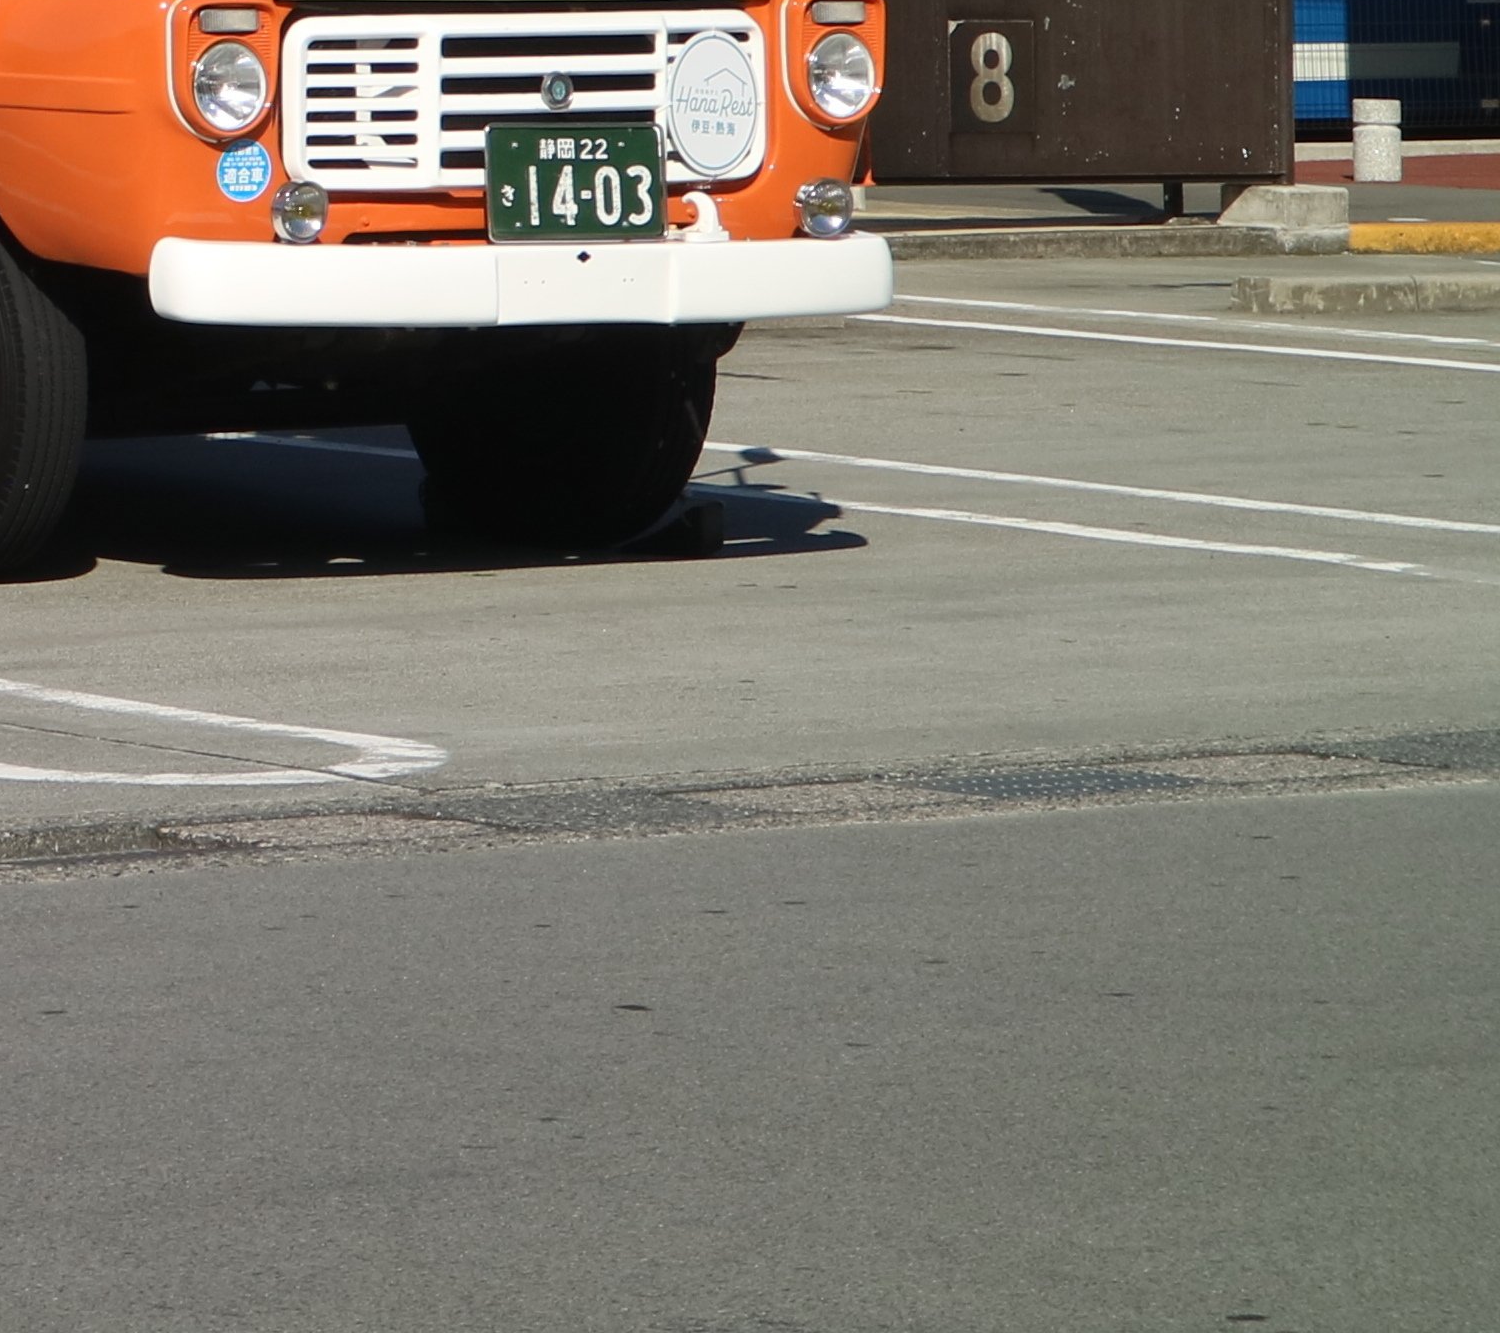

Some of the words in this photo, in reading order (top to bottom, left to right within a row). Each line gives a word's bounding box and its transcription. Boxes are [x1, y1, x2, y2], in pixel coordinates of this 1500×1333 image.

[970, 32, 1014, 123] 8
[538, 138, 575, 160] 静岡
[579, 138, 609, 160] 22
[223, 167, 265, 184] 適合車
[501, 184, 516, 207] さ
[528, 164, 653, 226] 14-03
